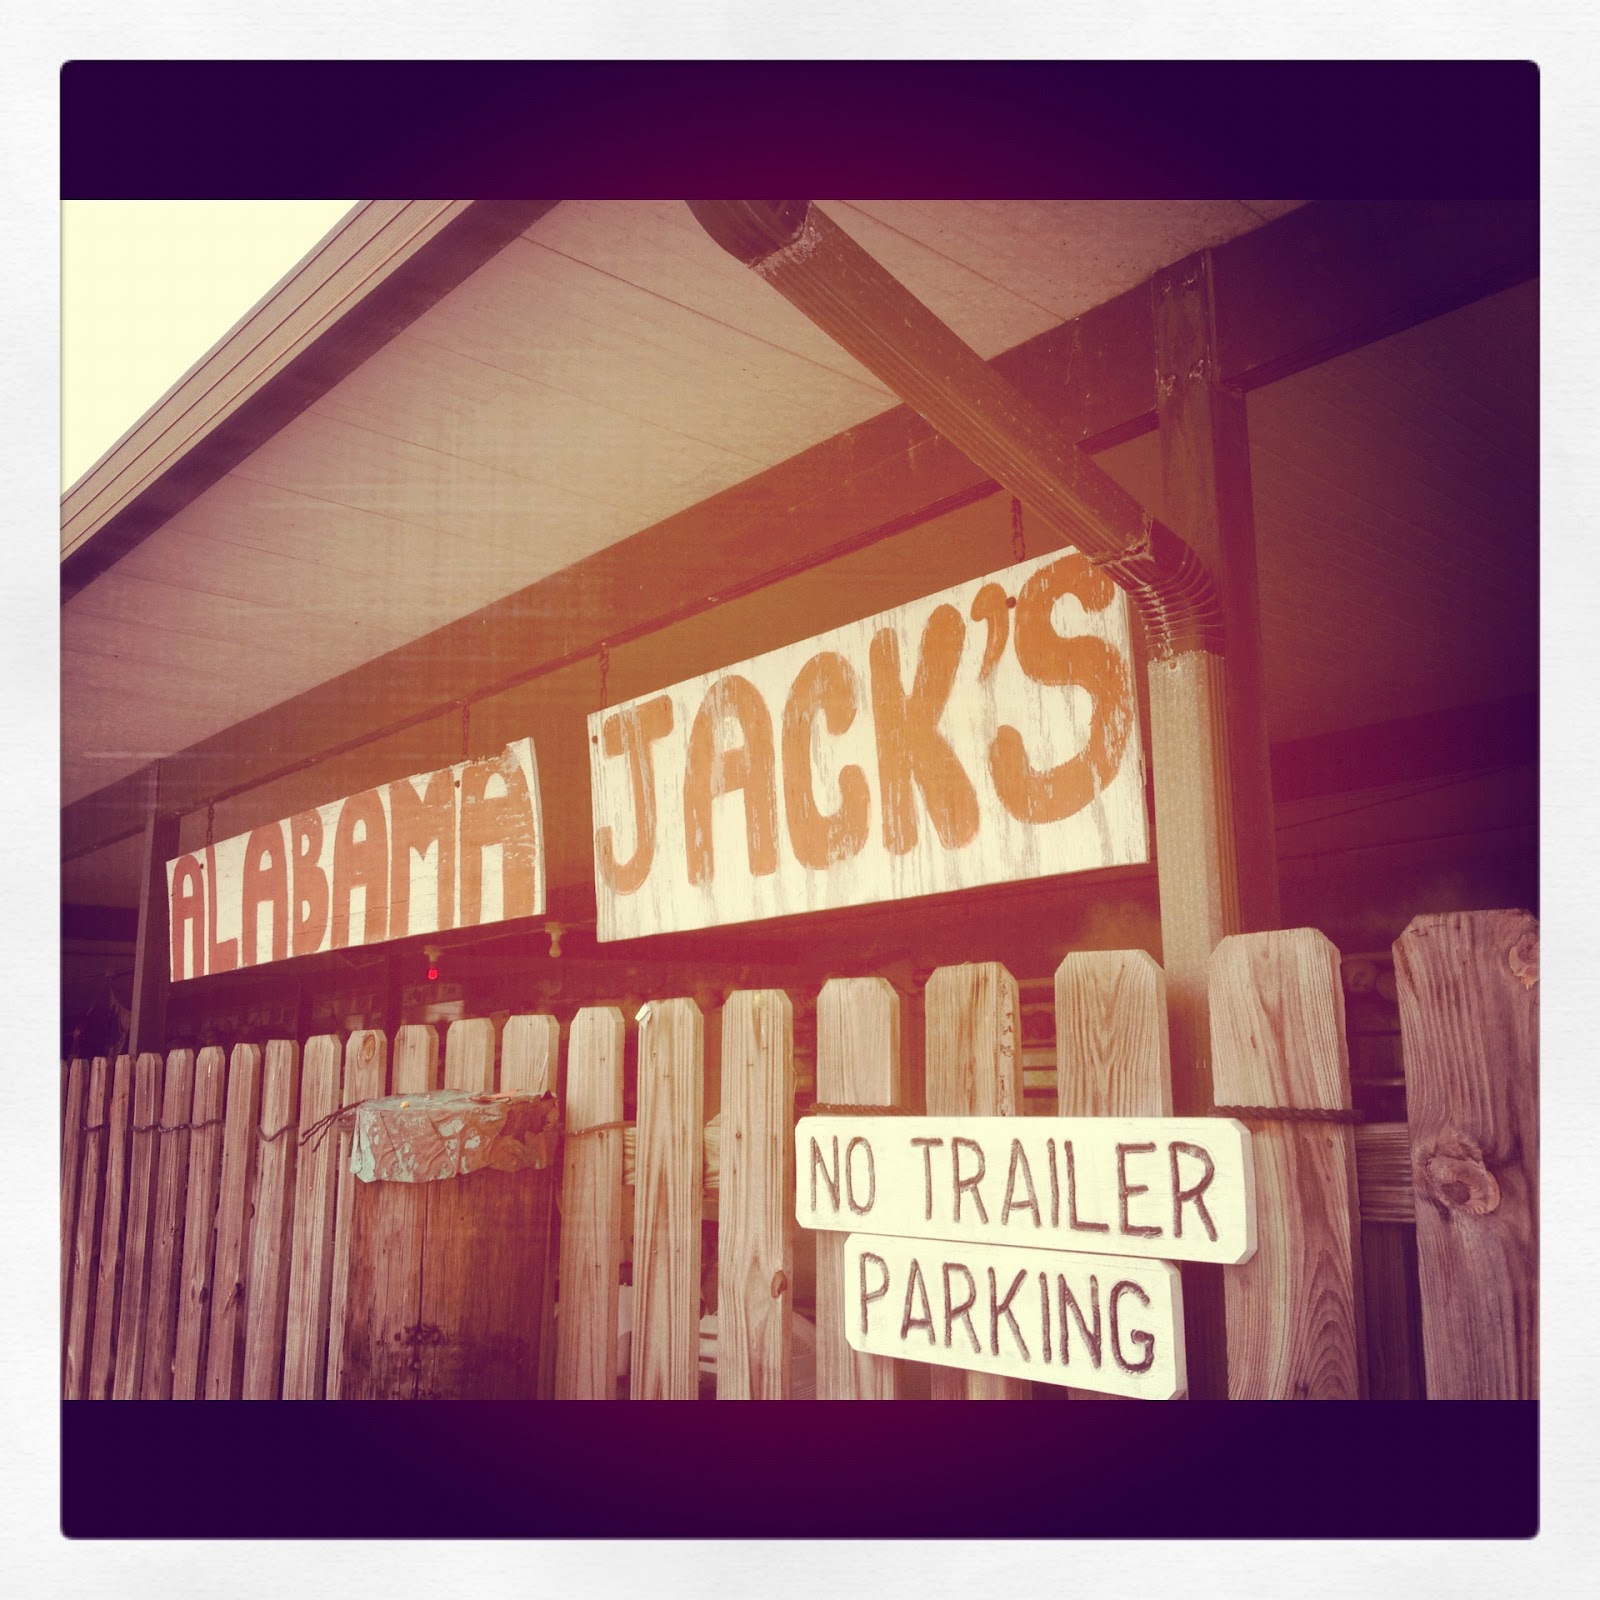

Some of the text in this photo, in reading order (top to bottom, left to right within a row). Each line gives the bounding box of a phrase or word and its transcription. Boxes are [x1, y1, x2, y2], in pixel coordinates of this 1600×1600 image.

[172, 552, 1134, 981] ALABAMA JACK'S
[810, 1135, 1219, 1242] NO TRAILER
[859, 1251, 1155, 1374] PARKING
